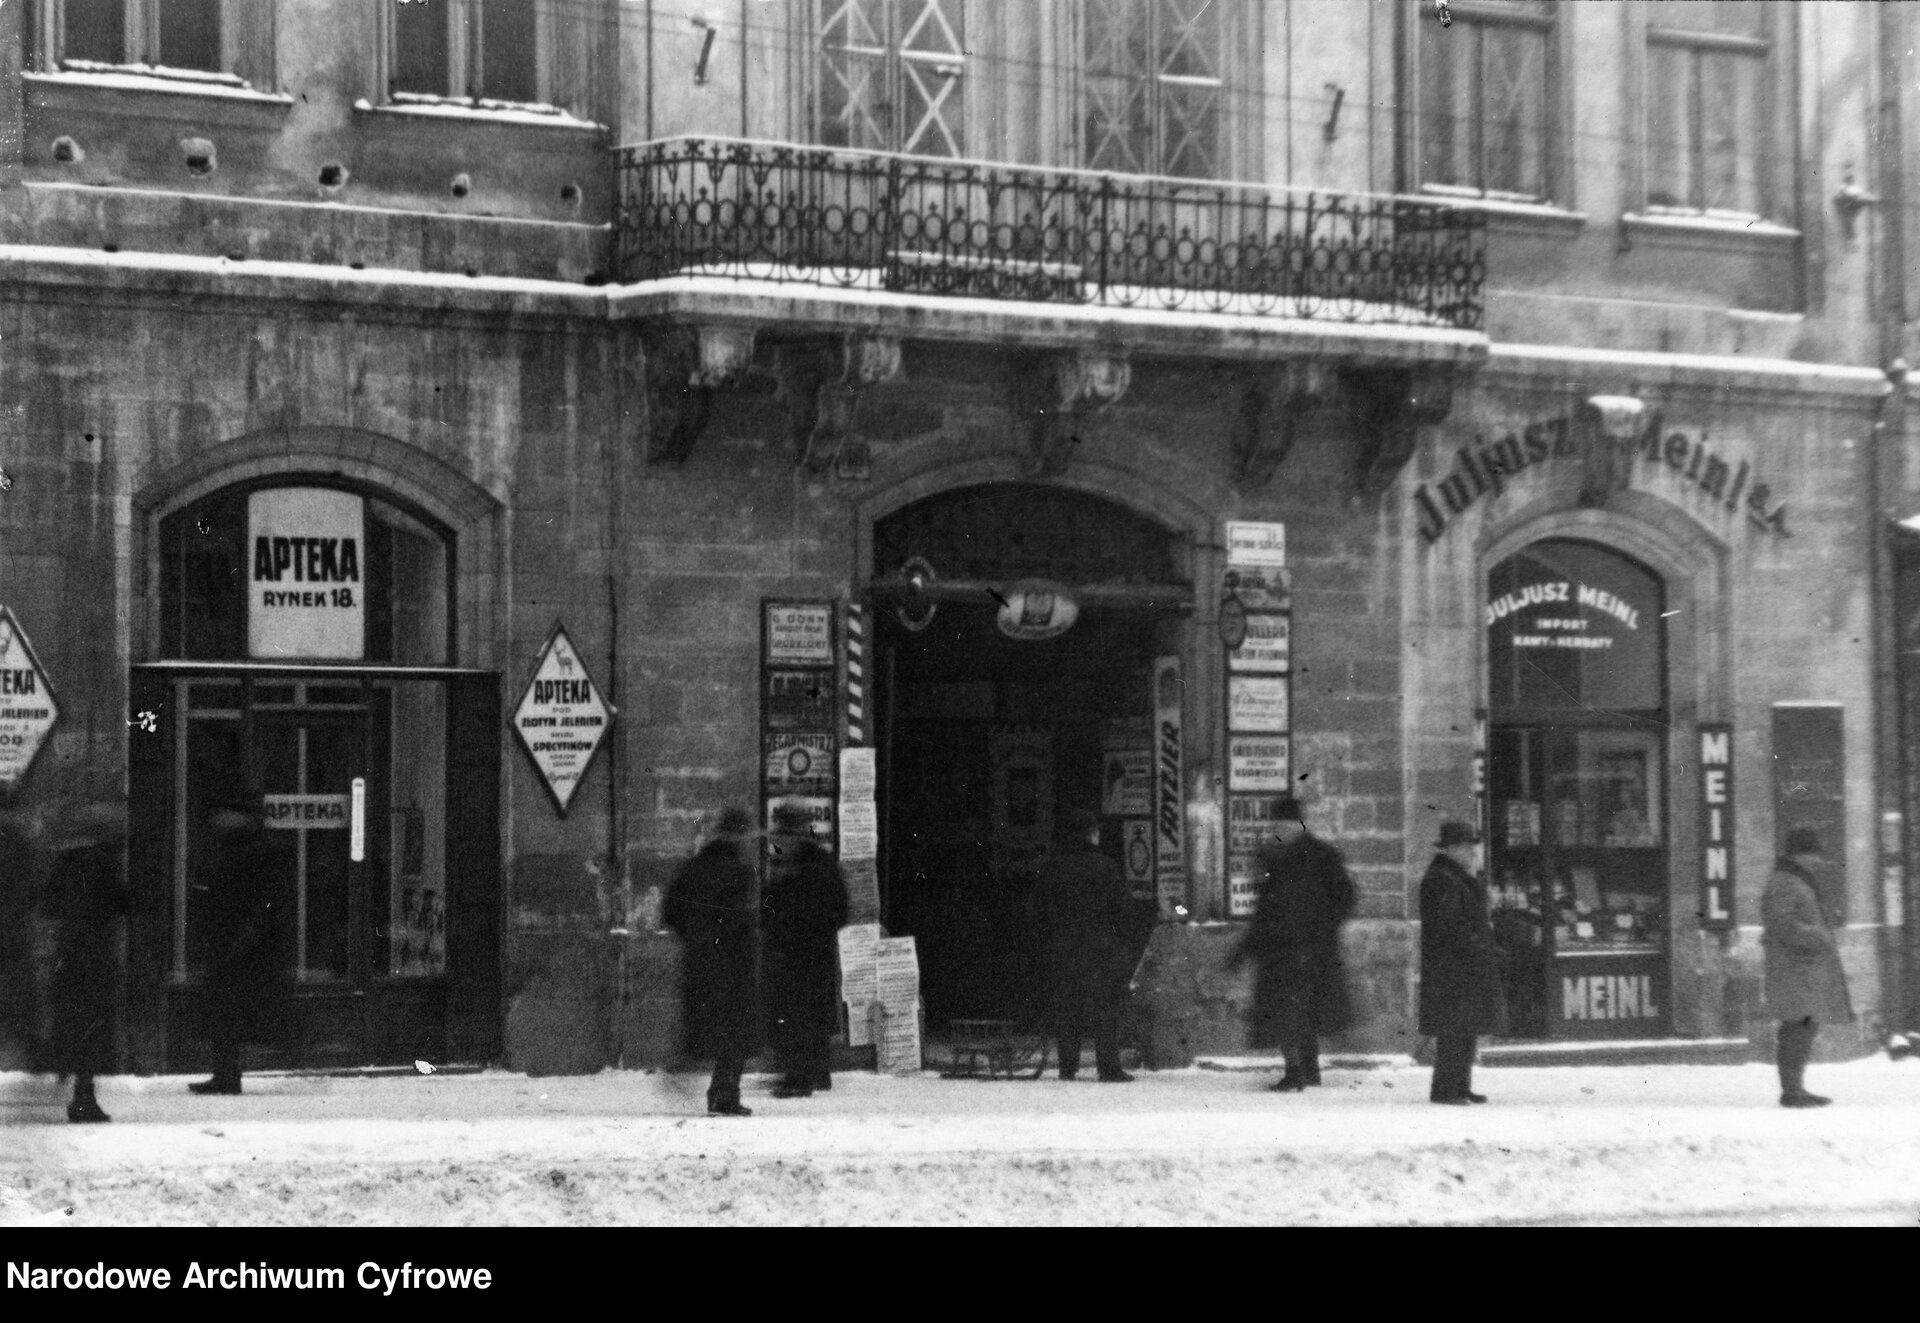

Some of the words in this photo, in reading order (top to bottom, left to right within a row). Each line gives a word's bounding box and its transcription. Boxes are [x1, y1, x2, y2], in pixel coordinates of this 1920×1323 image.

[1415, 417, 1574, 544] Juljusz
[254, 536, 359, 582] APTEKA
[263, 590, 326, 607] RYNEK
[331, 588, 357, 608] 18.
[1485, 582, 1569, 626] JULJUSZ
[1577, 584, 1639, 629] MEINL
[1537, 618, 1588, 629] IMPORT
[534, 679, 590, 704] APTEKA
[561, 716, 602, 727] JELENIEM
[765, 734, 834, 753] ZEGARMISTRZ
[264, 802, 344, 820] APTEKA
[1702, 732, 1729, 920] MEINL
[1563, 975, 1660, 1019] MEINL
